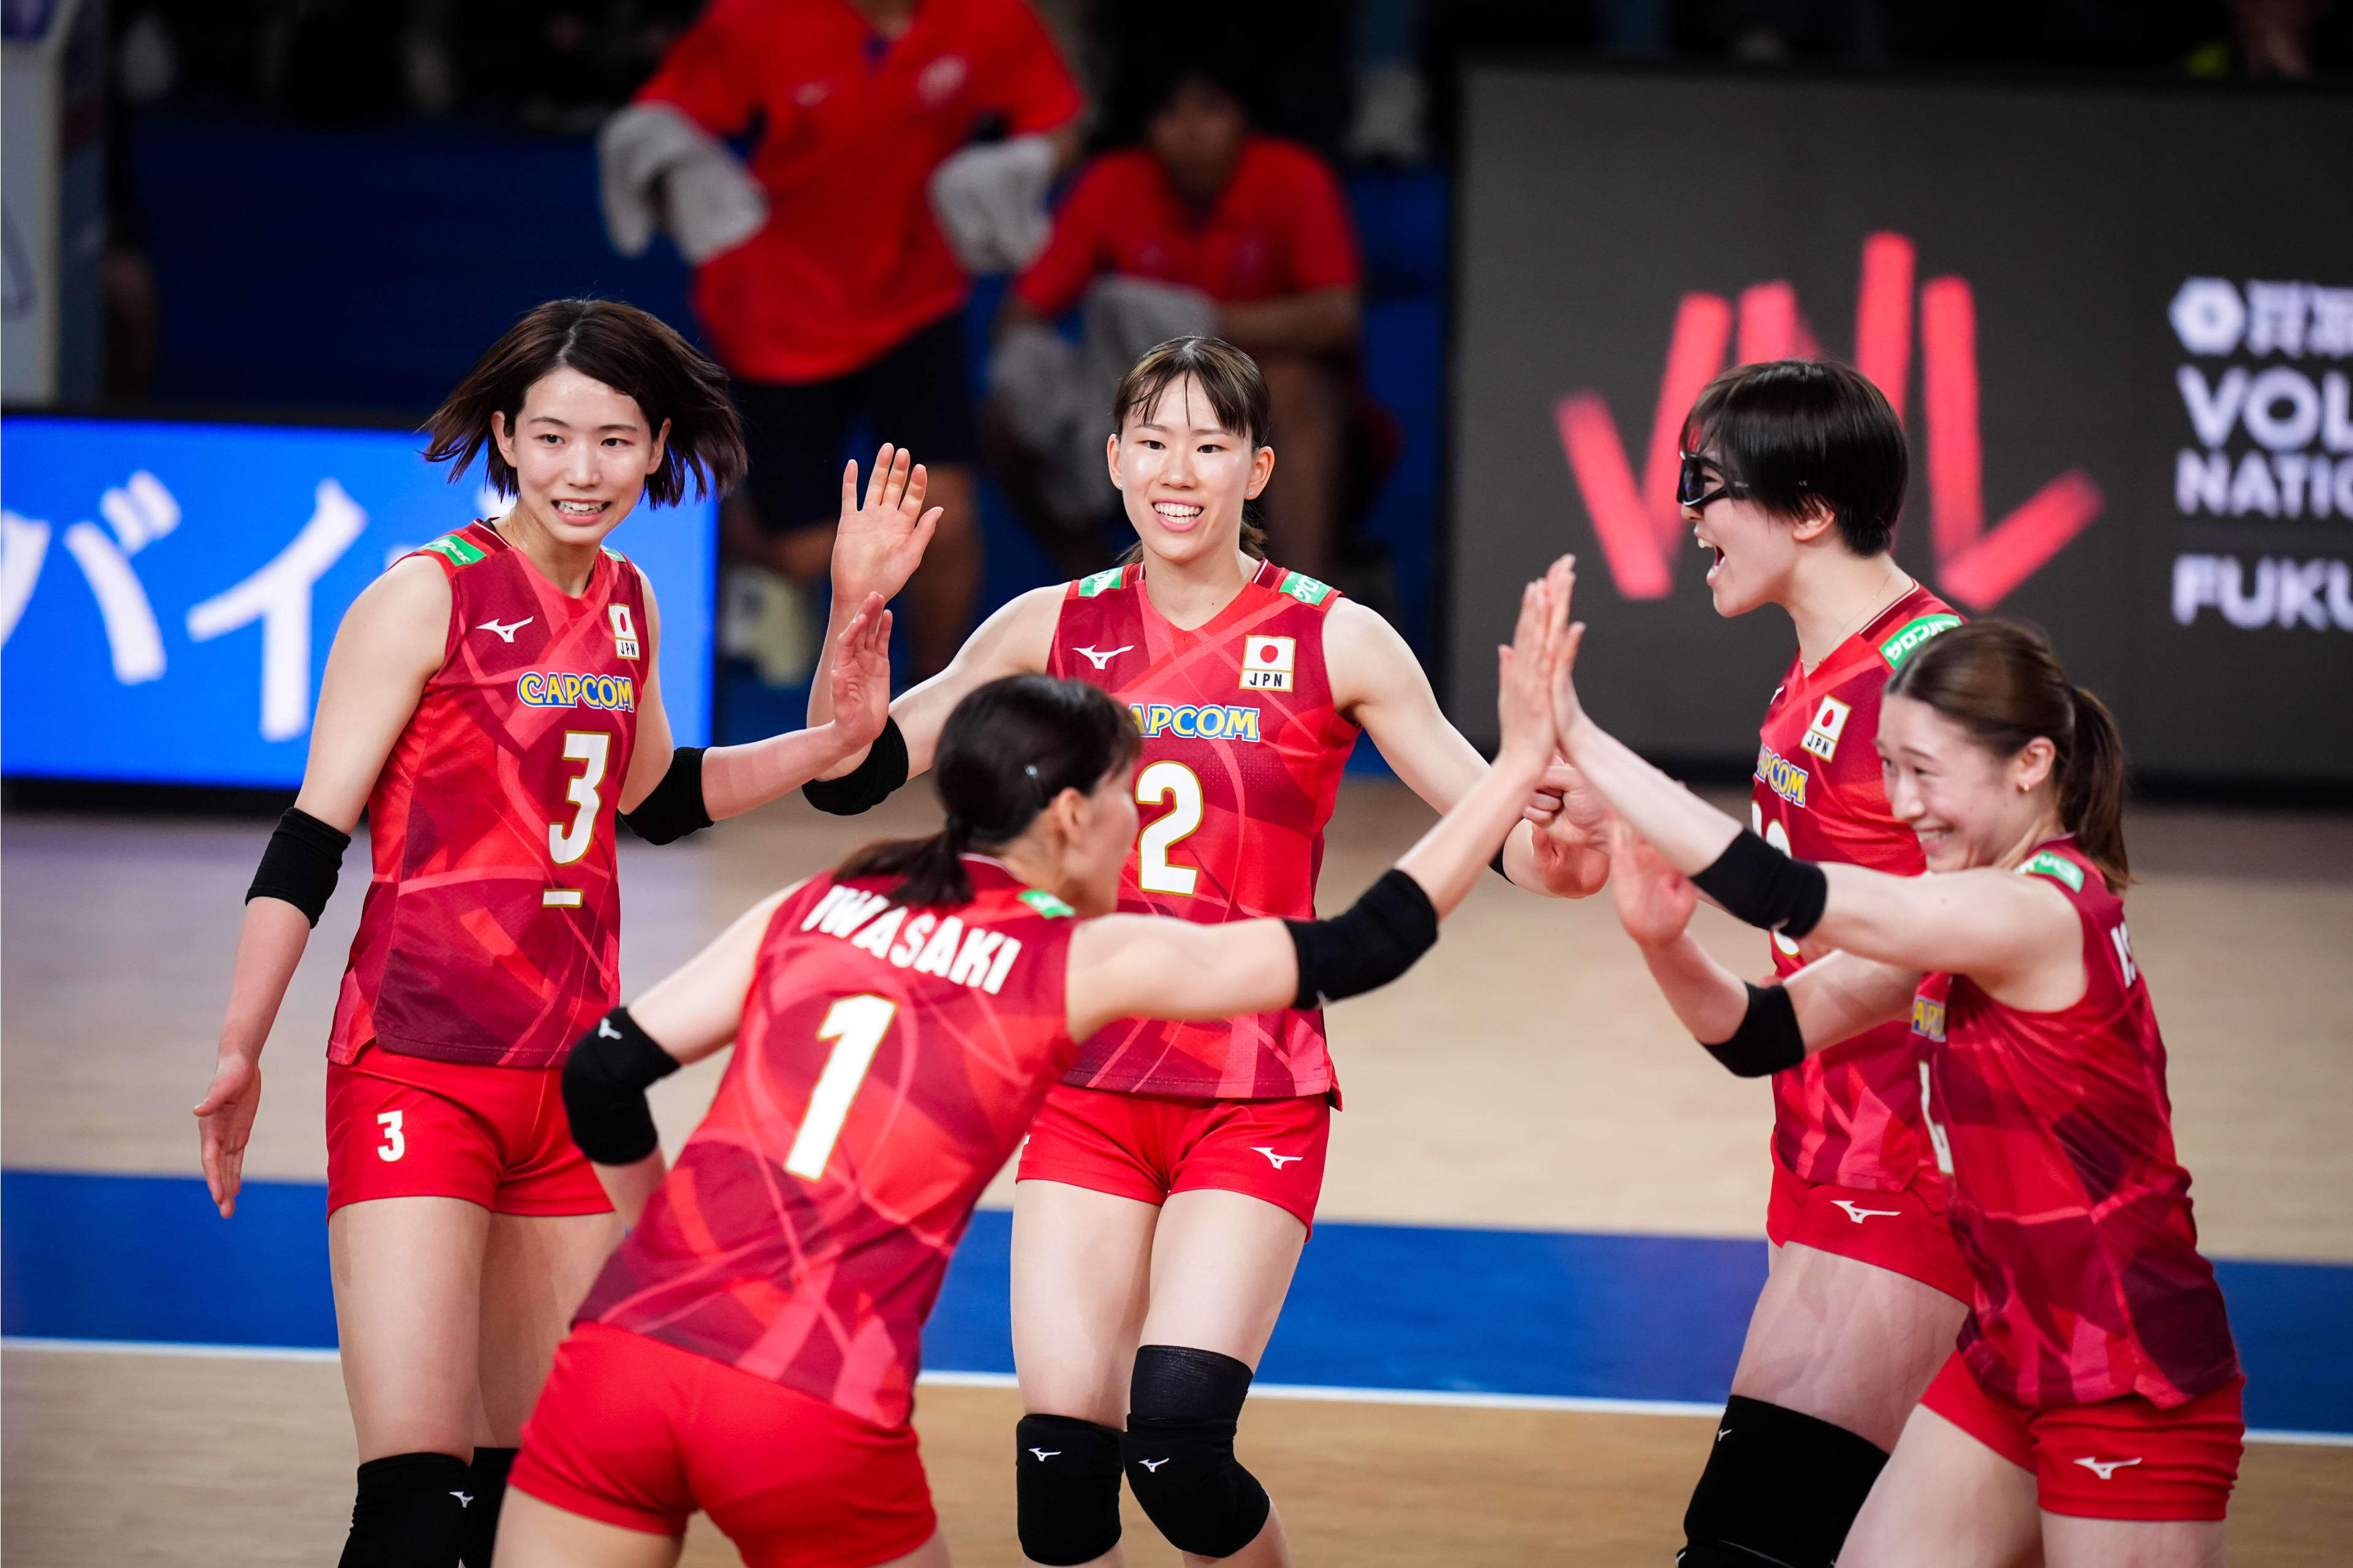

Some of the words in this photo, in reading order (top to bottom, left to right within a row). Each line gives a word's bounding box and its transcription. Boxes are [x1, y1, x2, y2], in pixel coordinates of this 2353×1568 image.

[2177, 364, 2353, 453] VOL
[621, 642, 636, 656] JPN
[517, 672, 635, 713] CAPCOM
[1249, 673, 1283, 687] JPN
[1129, 703, 1260, 742] APCOM
[1808, 735, 1829, 756] JPN
[548, 730, 611, 866] 3
[1135, 760, 1203, 896] 2
[800, 884, 1022, 994] IWASAKI
[784, 993, 899, 1183] 1
[377, 1110, 405, 1162] 3
